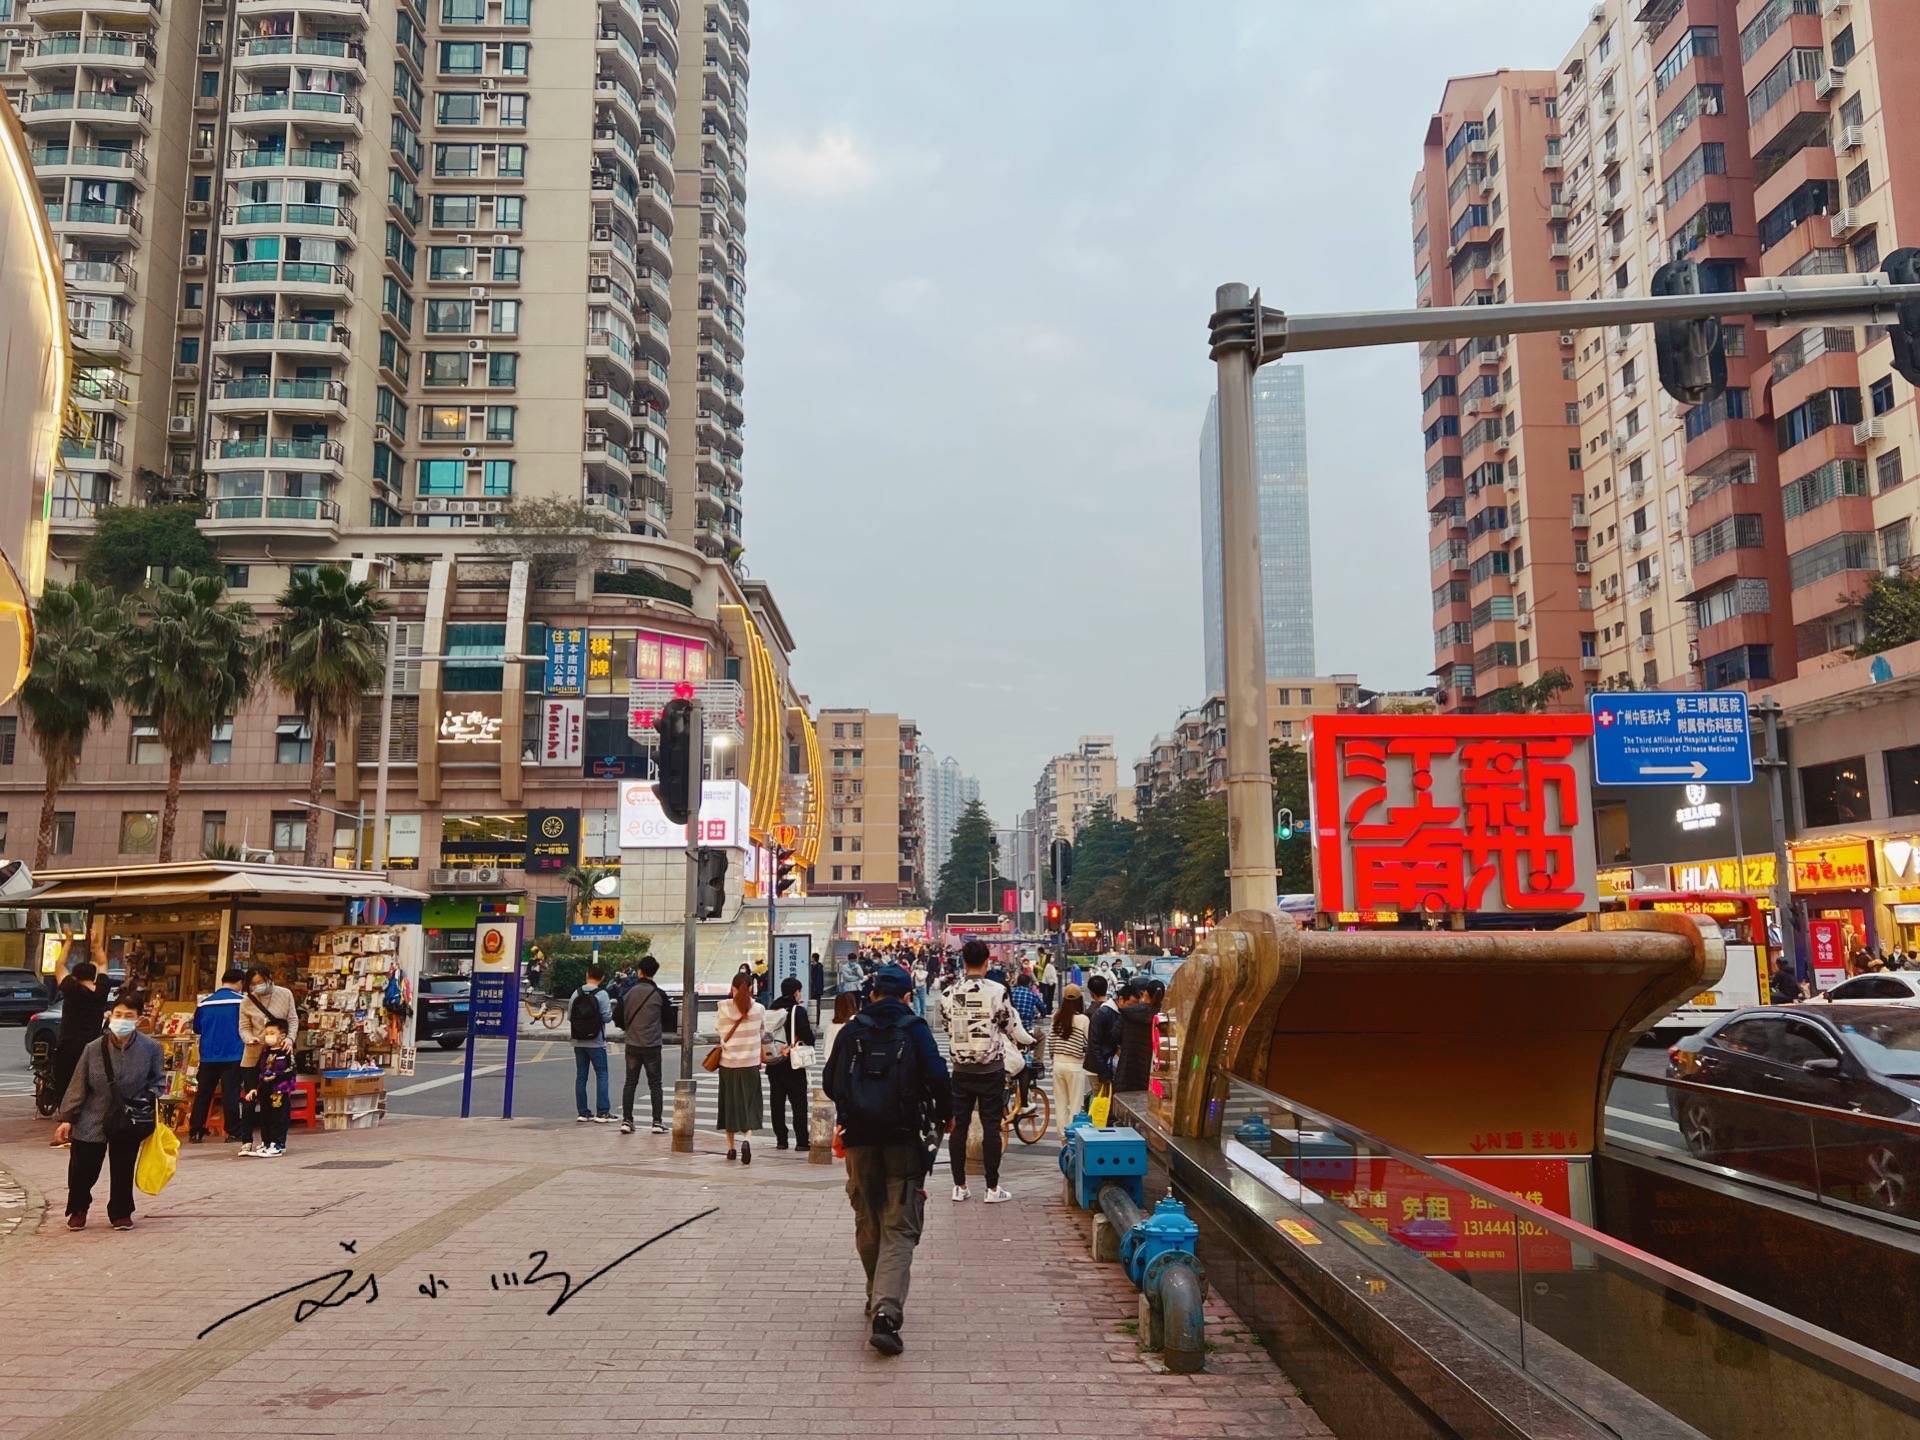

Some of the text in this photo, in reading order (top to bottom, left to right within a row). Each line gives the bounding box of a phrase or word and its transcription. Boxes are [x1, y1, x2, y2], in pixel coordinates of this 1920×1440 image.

[552, 630, 581, 643] 住宿
[590, 638, 611, 677] 棋牌
[1676, 697, 1741, 714] 第三附属医院
[1616, 709, 1671, 725] 广州中医药大学
[1677, 718, 1743, 734] 附属骨伤科医院
[1684, 736, 1710, 744] Hospital
[1719, 736, 1738, 744] Guang
[1624, 746, 1639, 754] zhou
[1640, 746, 1673, 754] University
[1708, 745, 1735, 753] Medicine
[1681, 865, 1720, 891] HLA
[1720, 861, 1776, 890] 海澜之家
[1402, 1195, 1451, 1221] 免租
[1463, 1220, 1549, 1236] 1314441302
